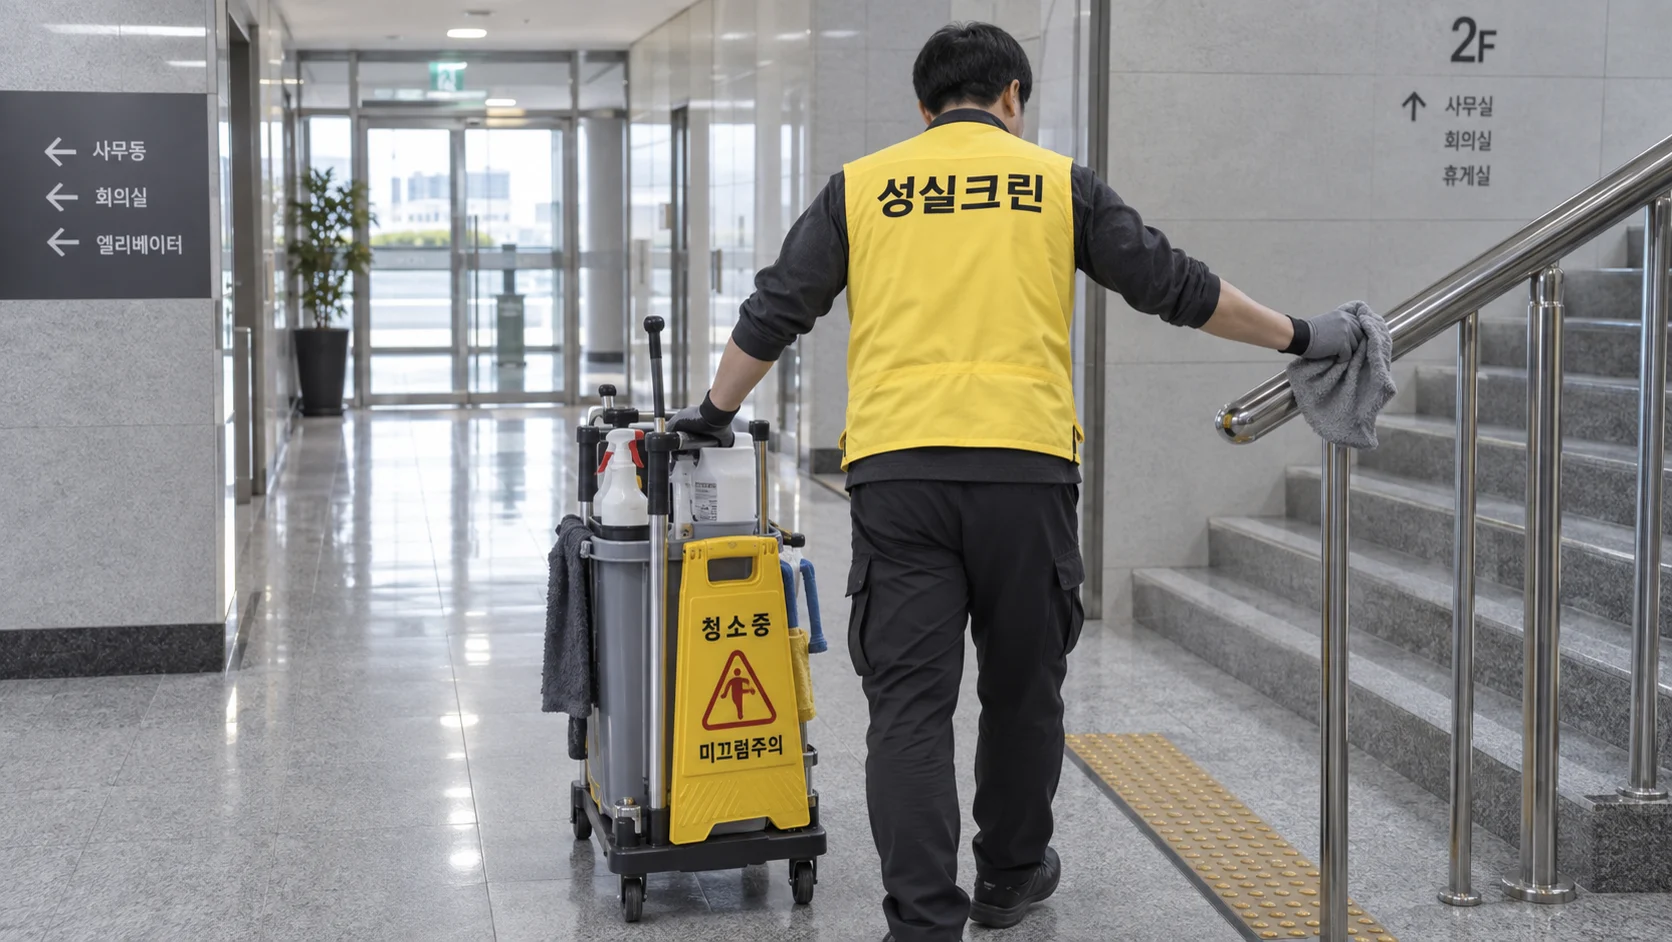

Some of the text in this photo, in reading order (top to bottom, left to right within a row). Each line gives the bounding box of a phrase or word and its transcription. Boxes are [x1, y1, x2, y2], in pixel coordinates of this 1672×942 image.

[1450, 16, 1497, 63] 2F
[1445, 95, 1493, 117] 사무실
[92, 140, 147, 161] 사무동
[1444, 130, 1492, 151] 회의실
[1442, 164, 1491, 187] 휴게실
[95, 187, 147, 208] 회의실
[877, 173, 1043, 218] 성실크린
[96, 234, 183, 255] 엘리베이터
[701, 612, 771, 642] 청소중
[699, 734, 783, 764] 미끄럼주의
